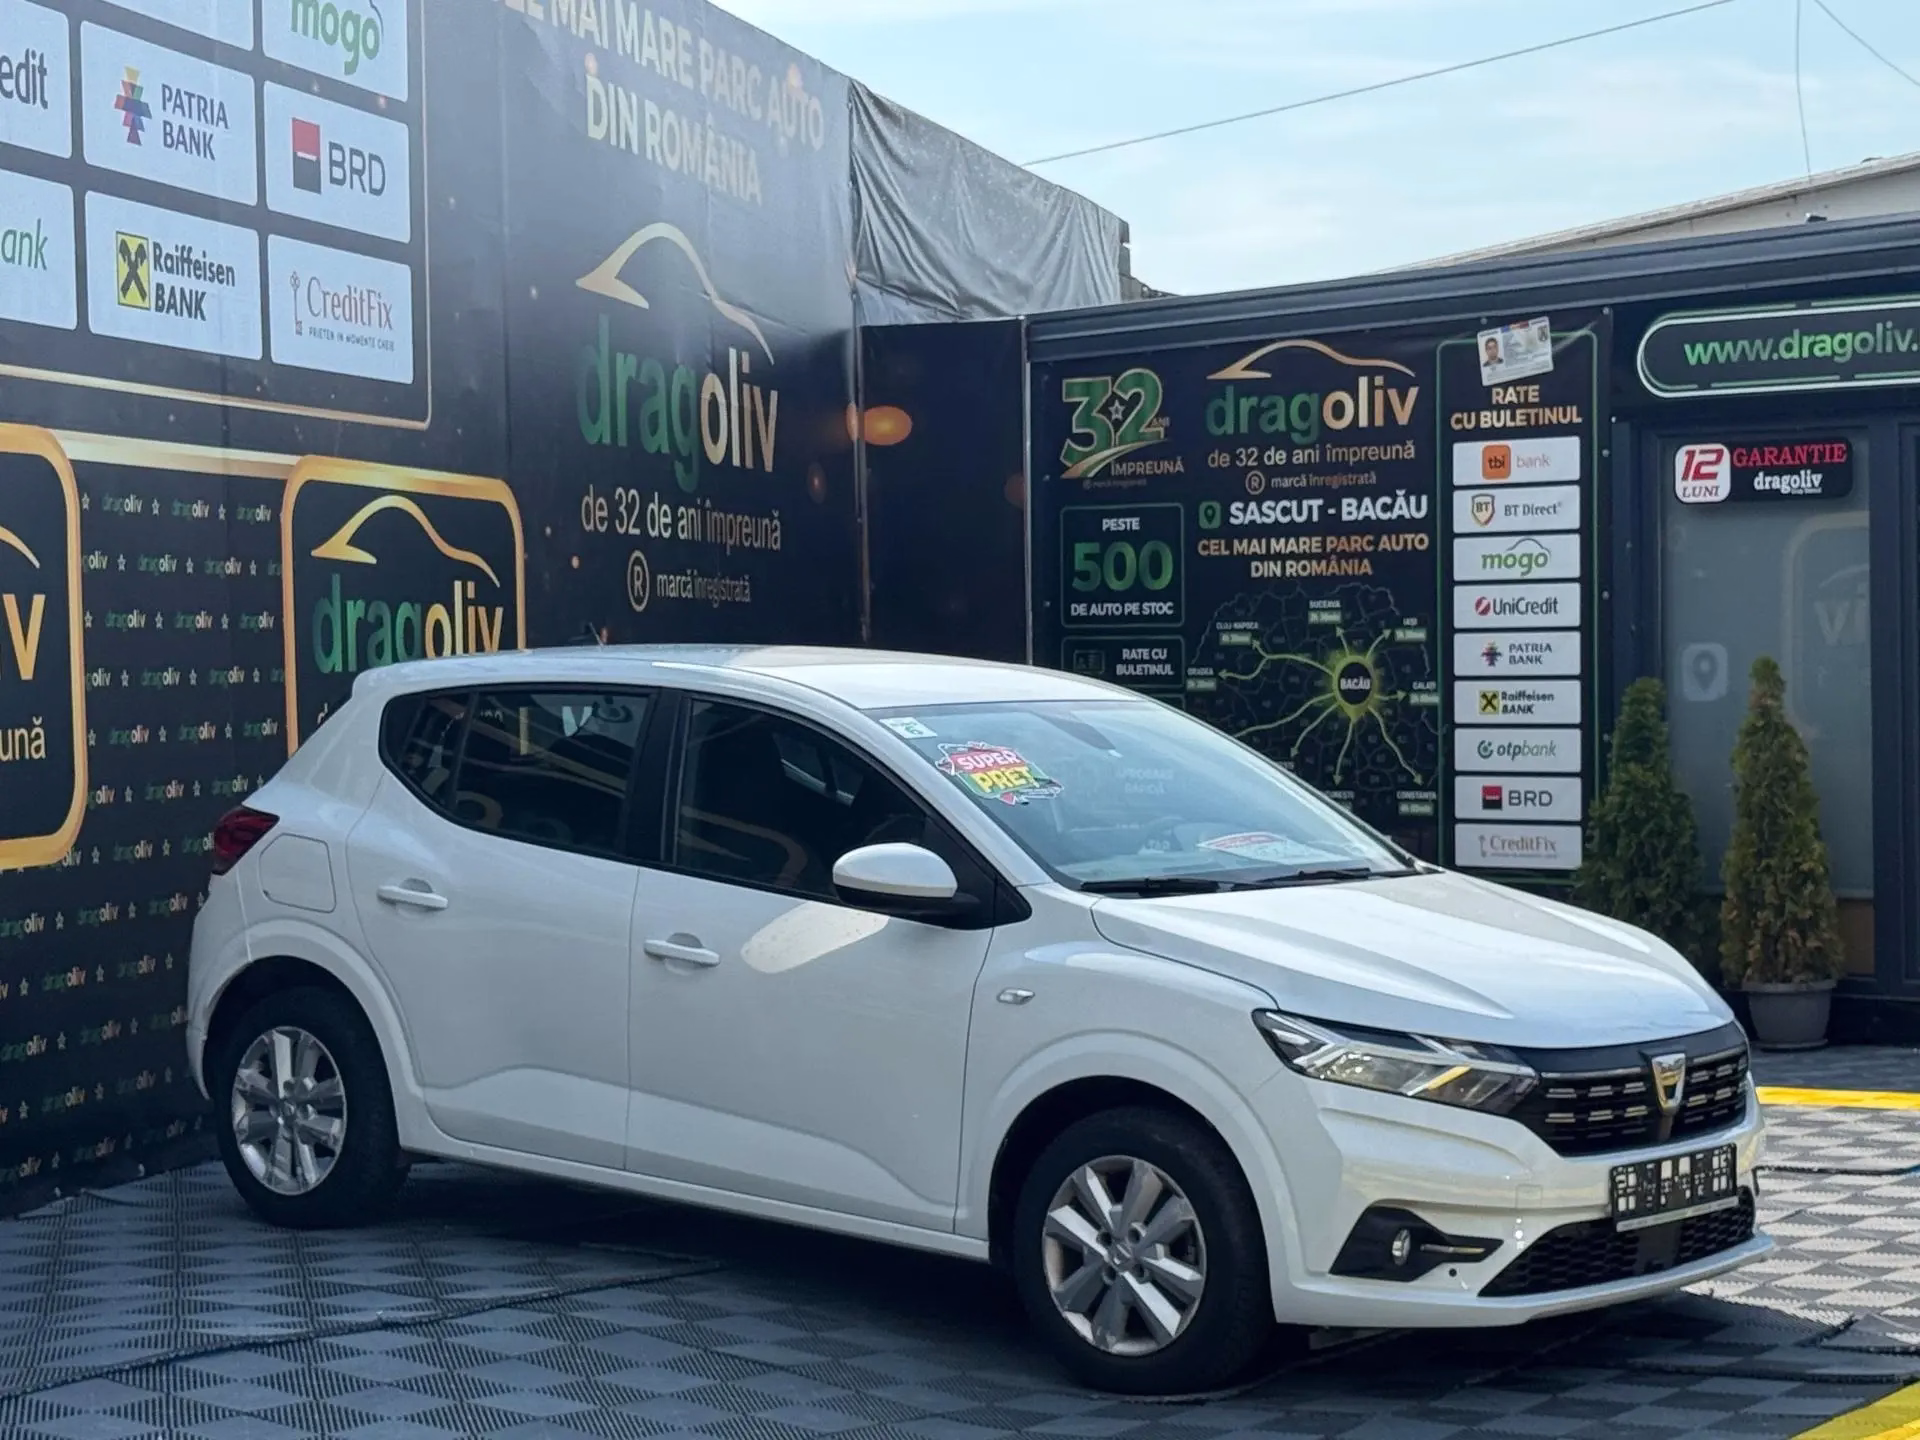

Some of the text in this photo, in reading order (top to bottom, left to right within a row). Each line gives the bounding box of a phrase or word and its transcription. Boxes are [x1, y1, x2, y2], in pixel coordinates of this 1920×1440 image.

[289, 0, 380, 75] mogo
[615, 2, 694, 90] MARE
[700, 37, 762, 122] PARC
[768, 77, 825, 152] AUTO
[161, 83, 230, 130] PATRIA
[162, 119, 216, 161] BANK
[585, 74, 762, 206] DIN ROMÂNIA
[328, 140, 386, 197] BRD
[153, 241, 236, 288] Raiffeisen
[154, 282, 207, 322] BANK
[307, 276, 393, 331] CreditFix
[576, 313, 778, 493] dragoliv
[1491, 385, 1541, 405] RATE
[1060, 368, 1165, 468] 32
[1206, 375, 1419, 445] dragoliv
[1450, 405, 1583, 430] CU BULETINUL
[1110, 456, 1185, 477] ÎMPREUNĂ
[1208, 440, 1416, 469] de 32 de ani împreună
[1488, 454, 1506, 471] tbi
[1516, 452, 1551, 469] bank
[1681, 448, 1724, 482] 12
[1733, 443, 1848, 467] GARANTIE
[1271, 474, 1307, 488] marcă
[1682, 485, 1720, 498] LUNI
[1753, 469, 1823, 495] dragoliv
[1229, 498, 1324, 525] SASCUT
[1341, 488, 1428, 522] BACĂU
[1504, 504, 1519, 517] BT
[581, 483, 781, 556] de 32 de ani împreună
[1102, 517, 1141, 532] PESTE
[1198, 532, 1429, 557] CEL MAI MARE PARC AUTO
[1072, 540, 1174, 593] 500
[1250, 555, 1373, 578] DIN ROMÂNIA
[1481, 551, 1549, 577] mogo
[656, 569, 693, 599] marcă
[1071, 601, 1174, 617] DE AUTO PE STOC
[1492, 596, 1559, 616] UniCredit
[312, 573, 504, 674] dragoliv
[1122, 647, 1168, 662] RATE CU
[1508, 643, 1553, 654] PATRIA
[1508, 654, 1543, 665] BANK
[1115, 661, 1174, 677] BULETINUL
[1501, 690, 1555, 702] Raiffeisen
[1501, 703, 1535, 715] BANK
[957, 750, 1021, 771] SUPER
[1496, 740, 1557, 761] otpbank
[1508, 790, 1553, 808] BRD
[1489, 835, 1557, 852] CreditFix
